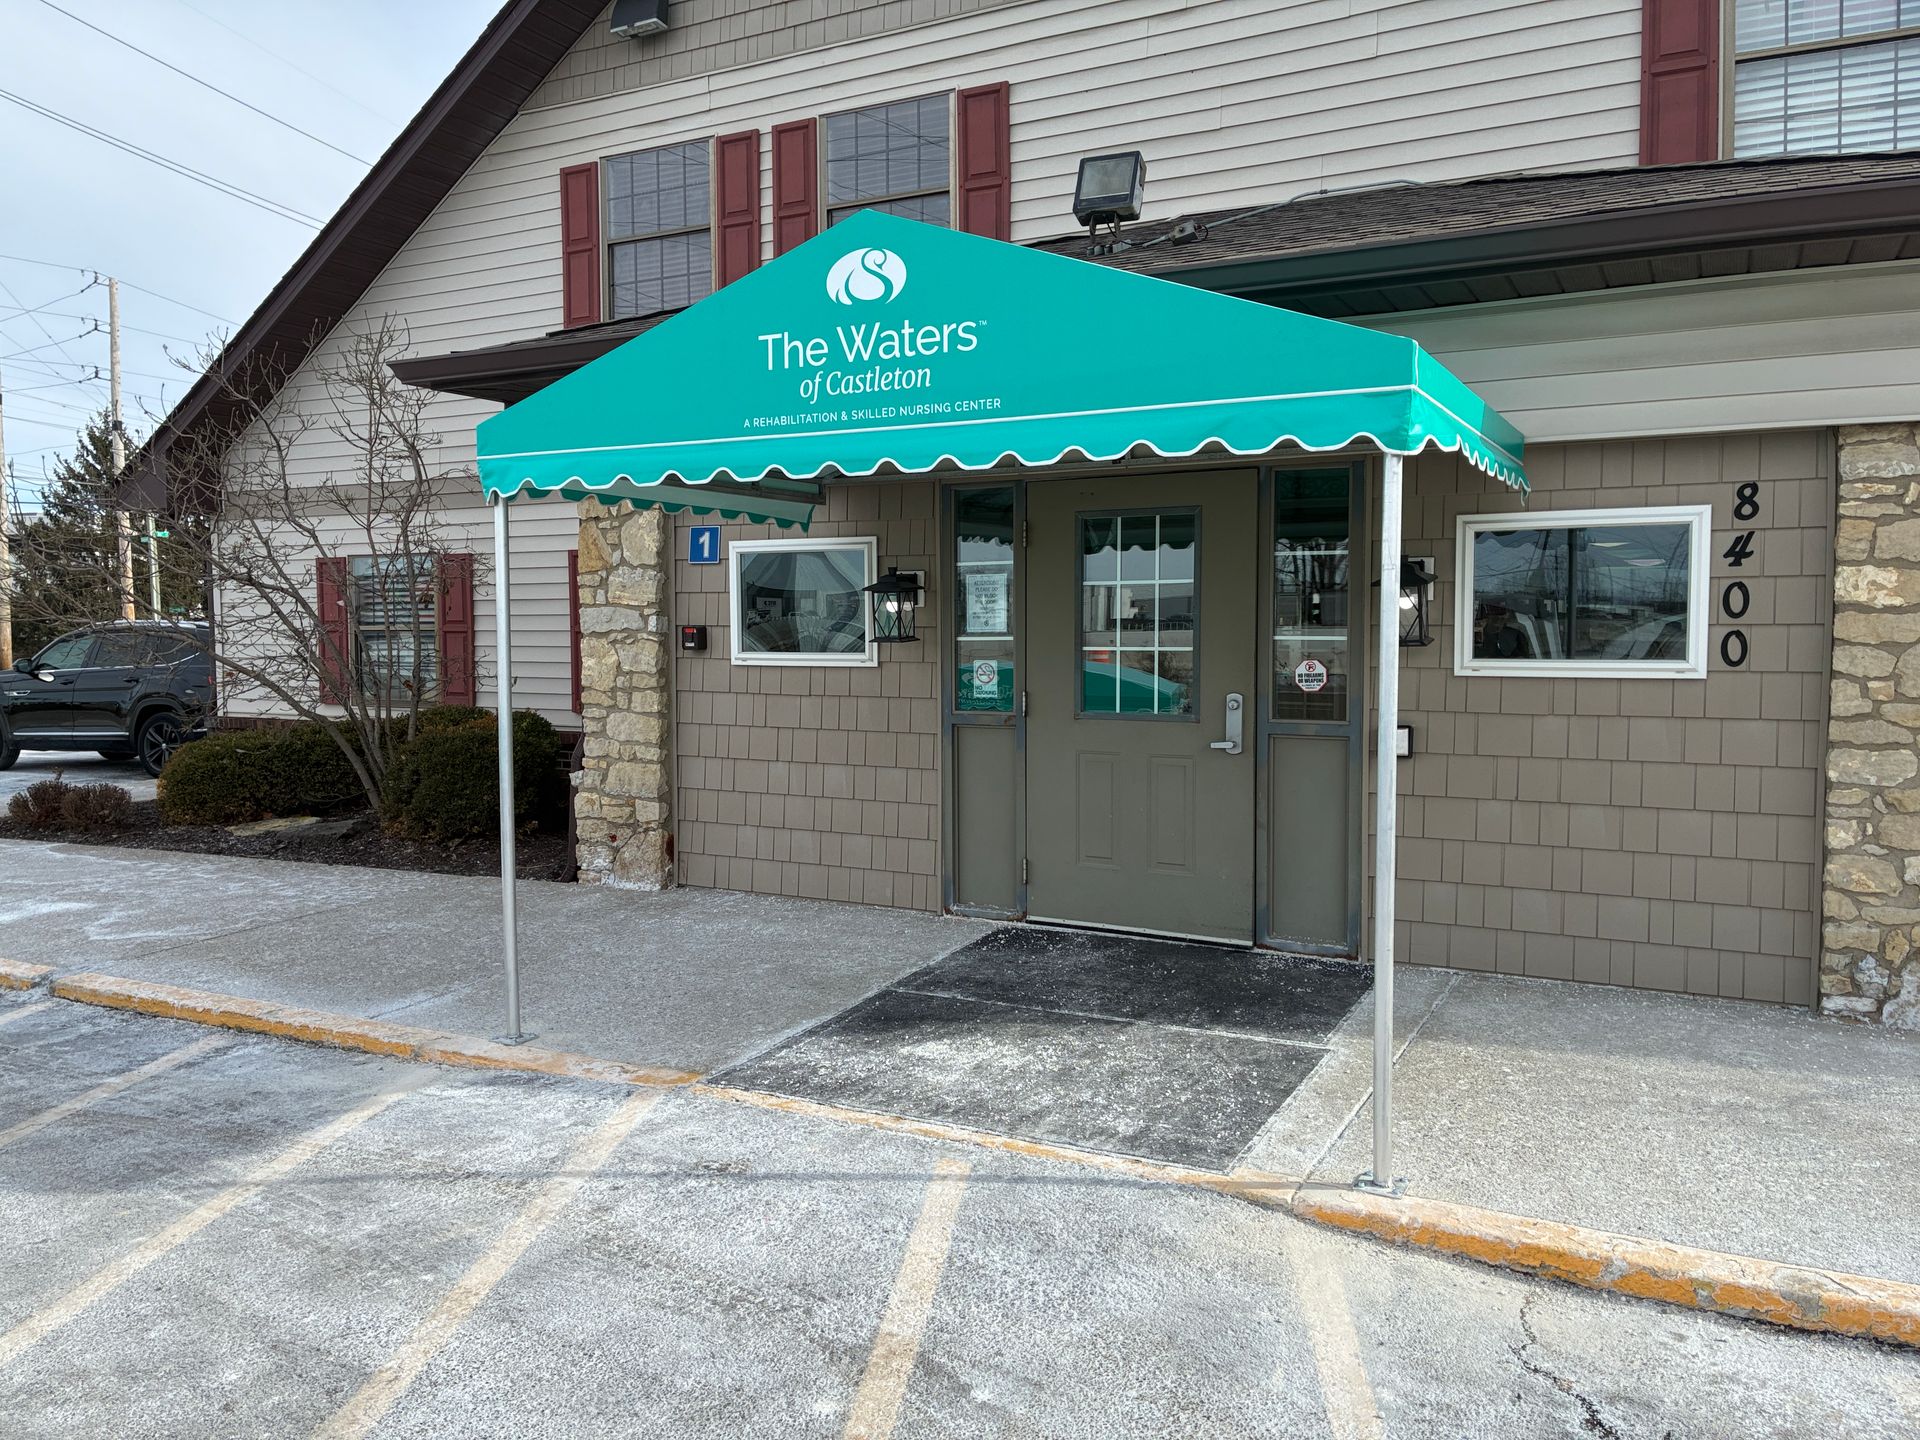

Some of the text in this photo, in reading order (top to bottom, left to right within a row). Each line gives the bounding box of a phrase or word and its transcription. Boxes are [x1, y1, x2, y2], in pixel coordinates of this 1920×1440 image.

[758, 331, 829, 371] The
[837, 319, 978, 363] Waters
[799, 365, 932, 405] of Castleton
[743, 398, 1001, 429] A REHABILITATION & SKILLED NURSING CENTER
[698, 531, 710, 558] 1
[1720, 481, 1760, 668] 8400
